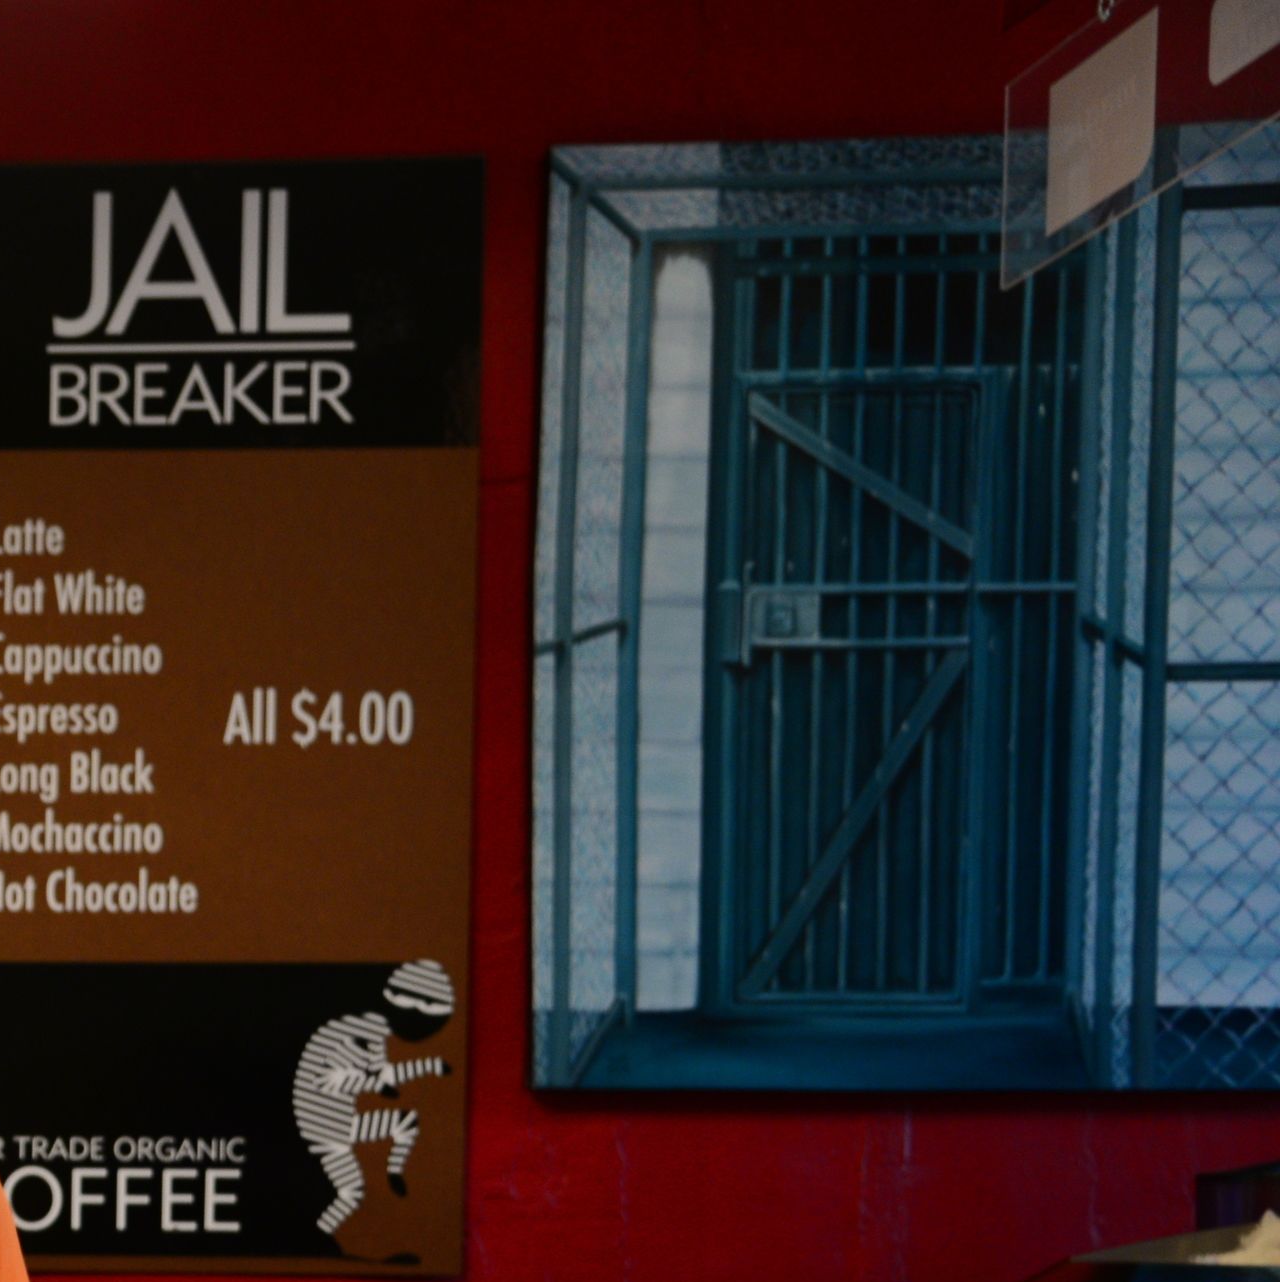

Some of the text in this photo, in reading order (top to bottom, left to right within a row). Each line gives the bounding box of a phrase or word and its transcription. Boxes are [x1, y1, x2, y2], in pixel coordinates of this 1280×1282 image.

[52, 187, 351, 338] JAIL
[49, 361, 354, 426] BREAKER
[54, 568, 146, 614] White
[222, 686, 414, 749] All $4.00
[70, 747, 154, 793] Black
[45, 867, 199, 913] Chocolate
[13, 1135, 105, 1162] TRADE
[113, 1136, 246, 1163] ORGANIC
[3, 1164, 242, 1232] OFFEE
